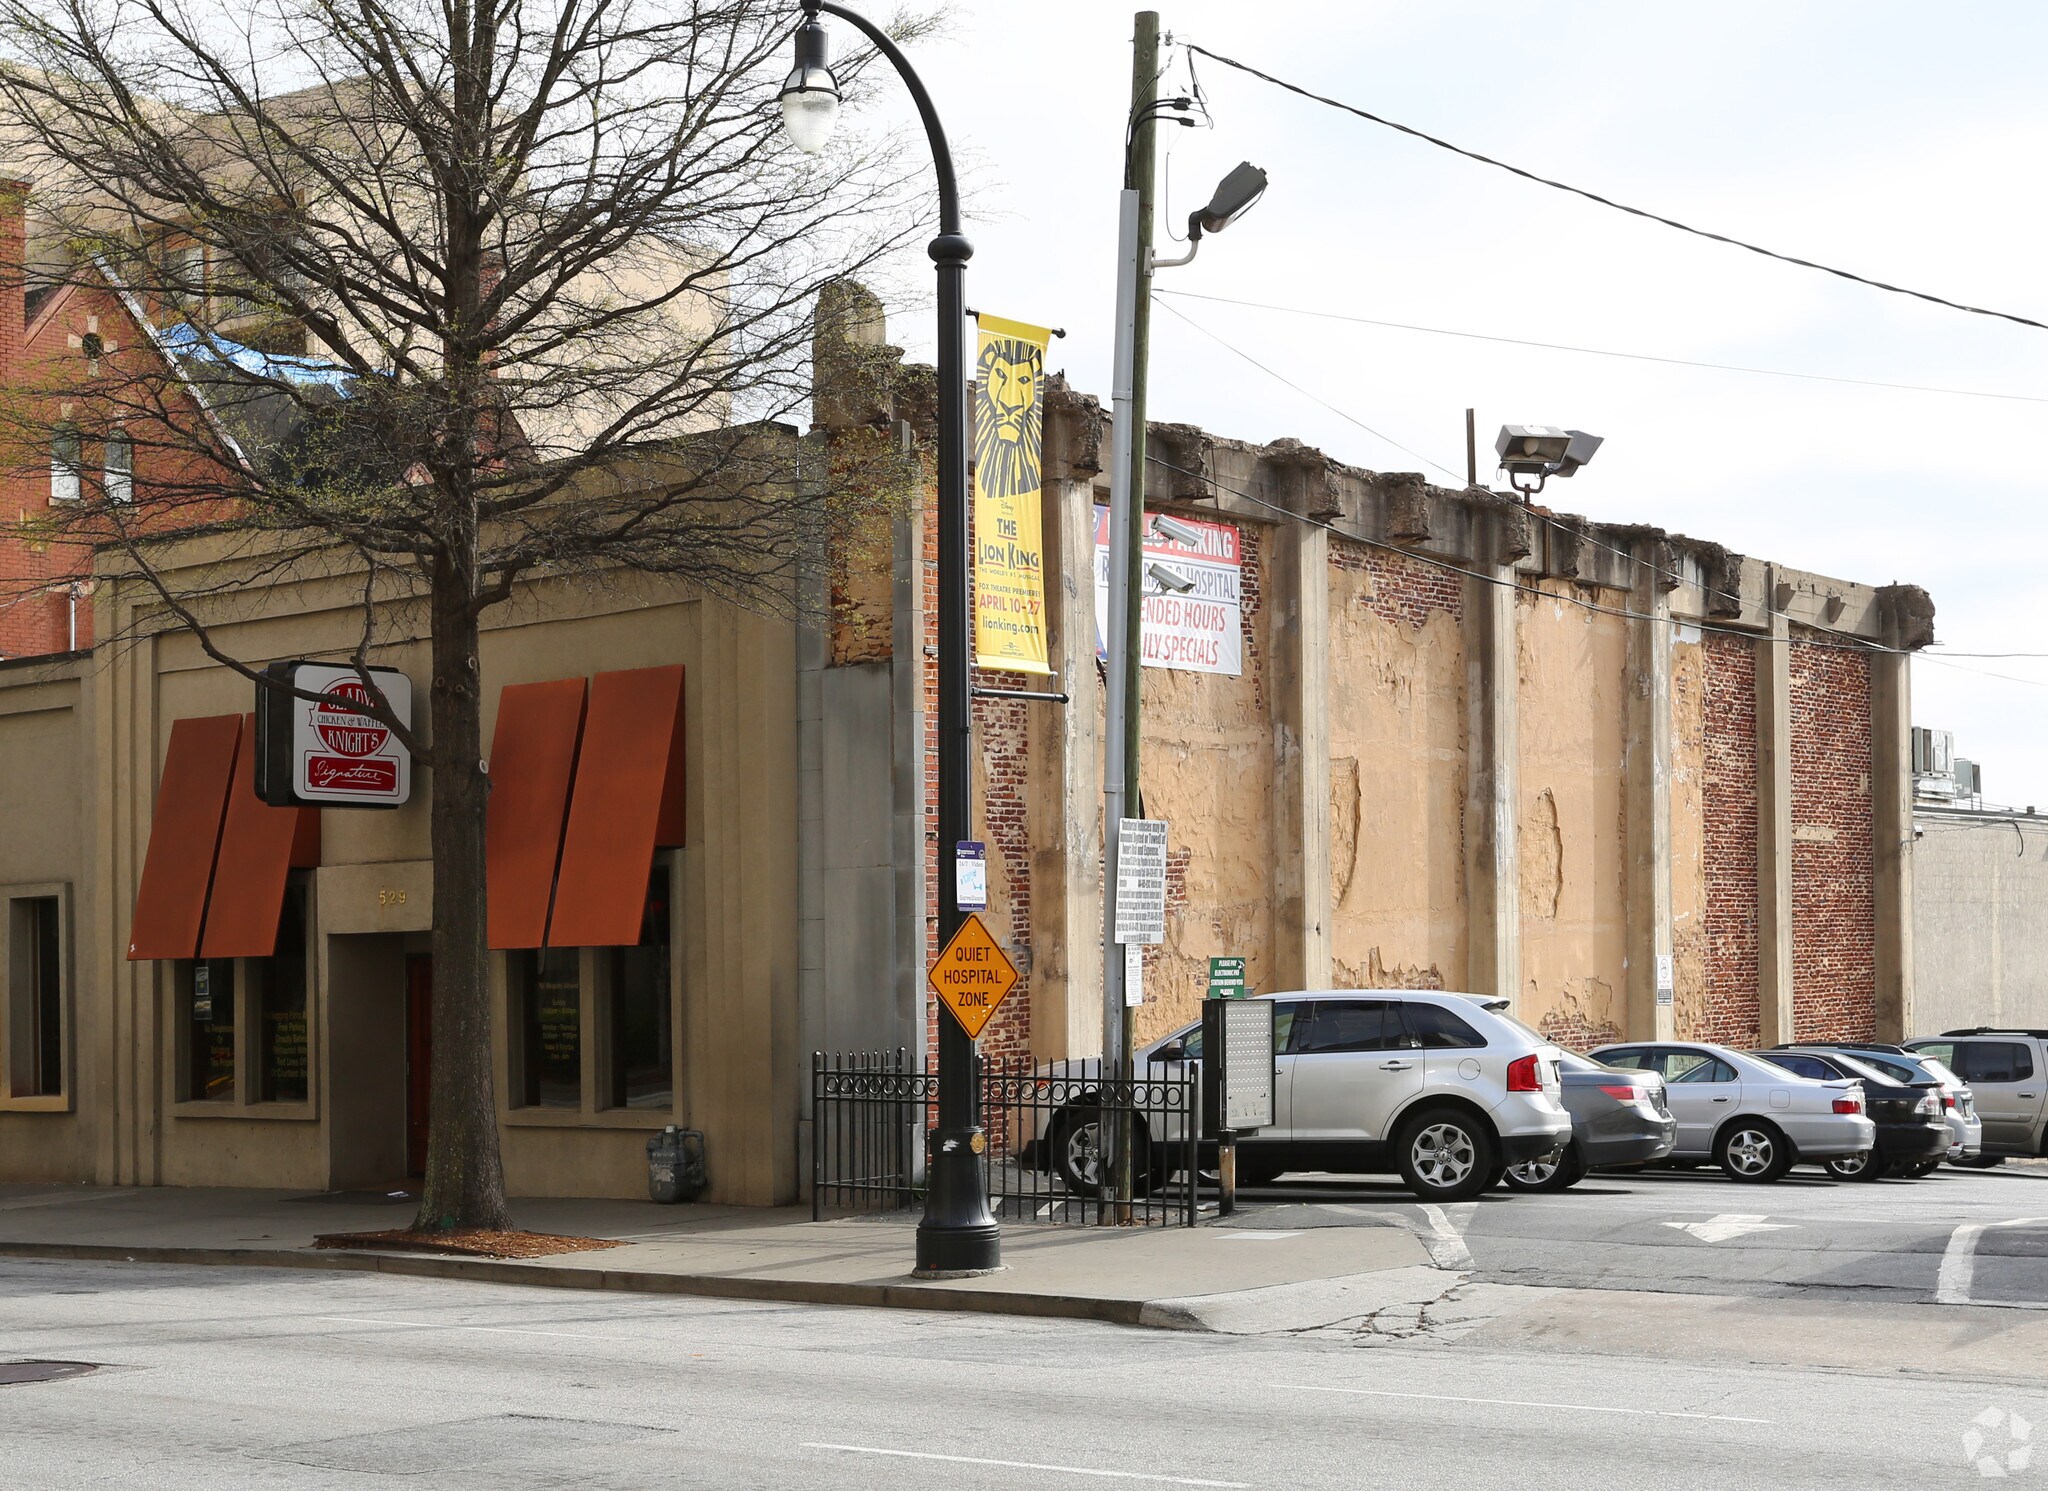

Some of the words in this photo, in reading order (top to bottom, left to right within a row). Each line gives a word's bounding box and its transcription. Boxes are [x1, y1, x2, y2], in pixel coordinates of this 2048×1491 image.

[997, 518, 1017, 537] THE
[1168, 523, 1233, 559] RKING
[978, 537, 1005, 565] LION
[1008, 542, 1039, 570] KING
[979, 582, 989, 590] FOX
[991, 584, 1012, 594] THEATRE
[1013, 587, 1041, 598] PREMIERE!
[1187, 566, 1236, 600] HOSPITAL
[979, 593, 1008, 612] APRIL
[1010, 597, 1041, 616] 10-27
[1141, 597, 1181, 627] ENDED
[1184, 602, 1226, 633] HOURS
[982, 615, 1039, 635] lionking.com
[1164, 634, 1219, 666] SPECIALS
[317, 714, 346, 727] CHICKEN
[356, 717, 388, 730] WAFFLE
[328, 729, 379, 754] KNIGHT'S
[314, 760, 394, 786] Signature
[380, 889, 406, 905] 529
[955, 947, 991, 962] QUIET
[944, 969, 1002, 984] HOSPITAL
[958, 991, 989, 1007] ZONE
